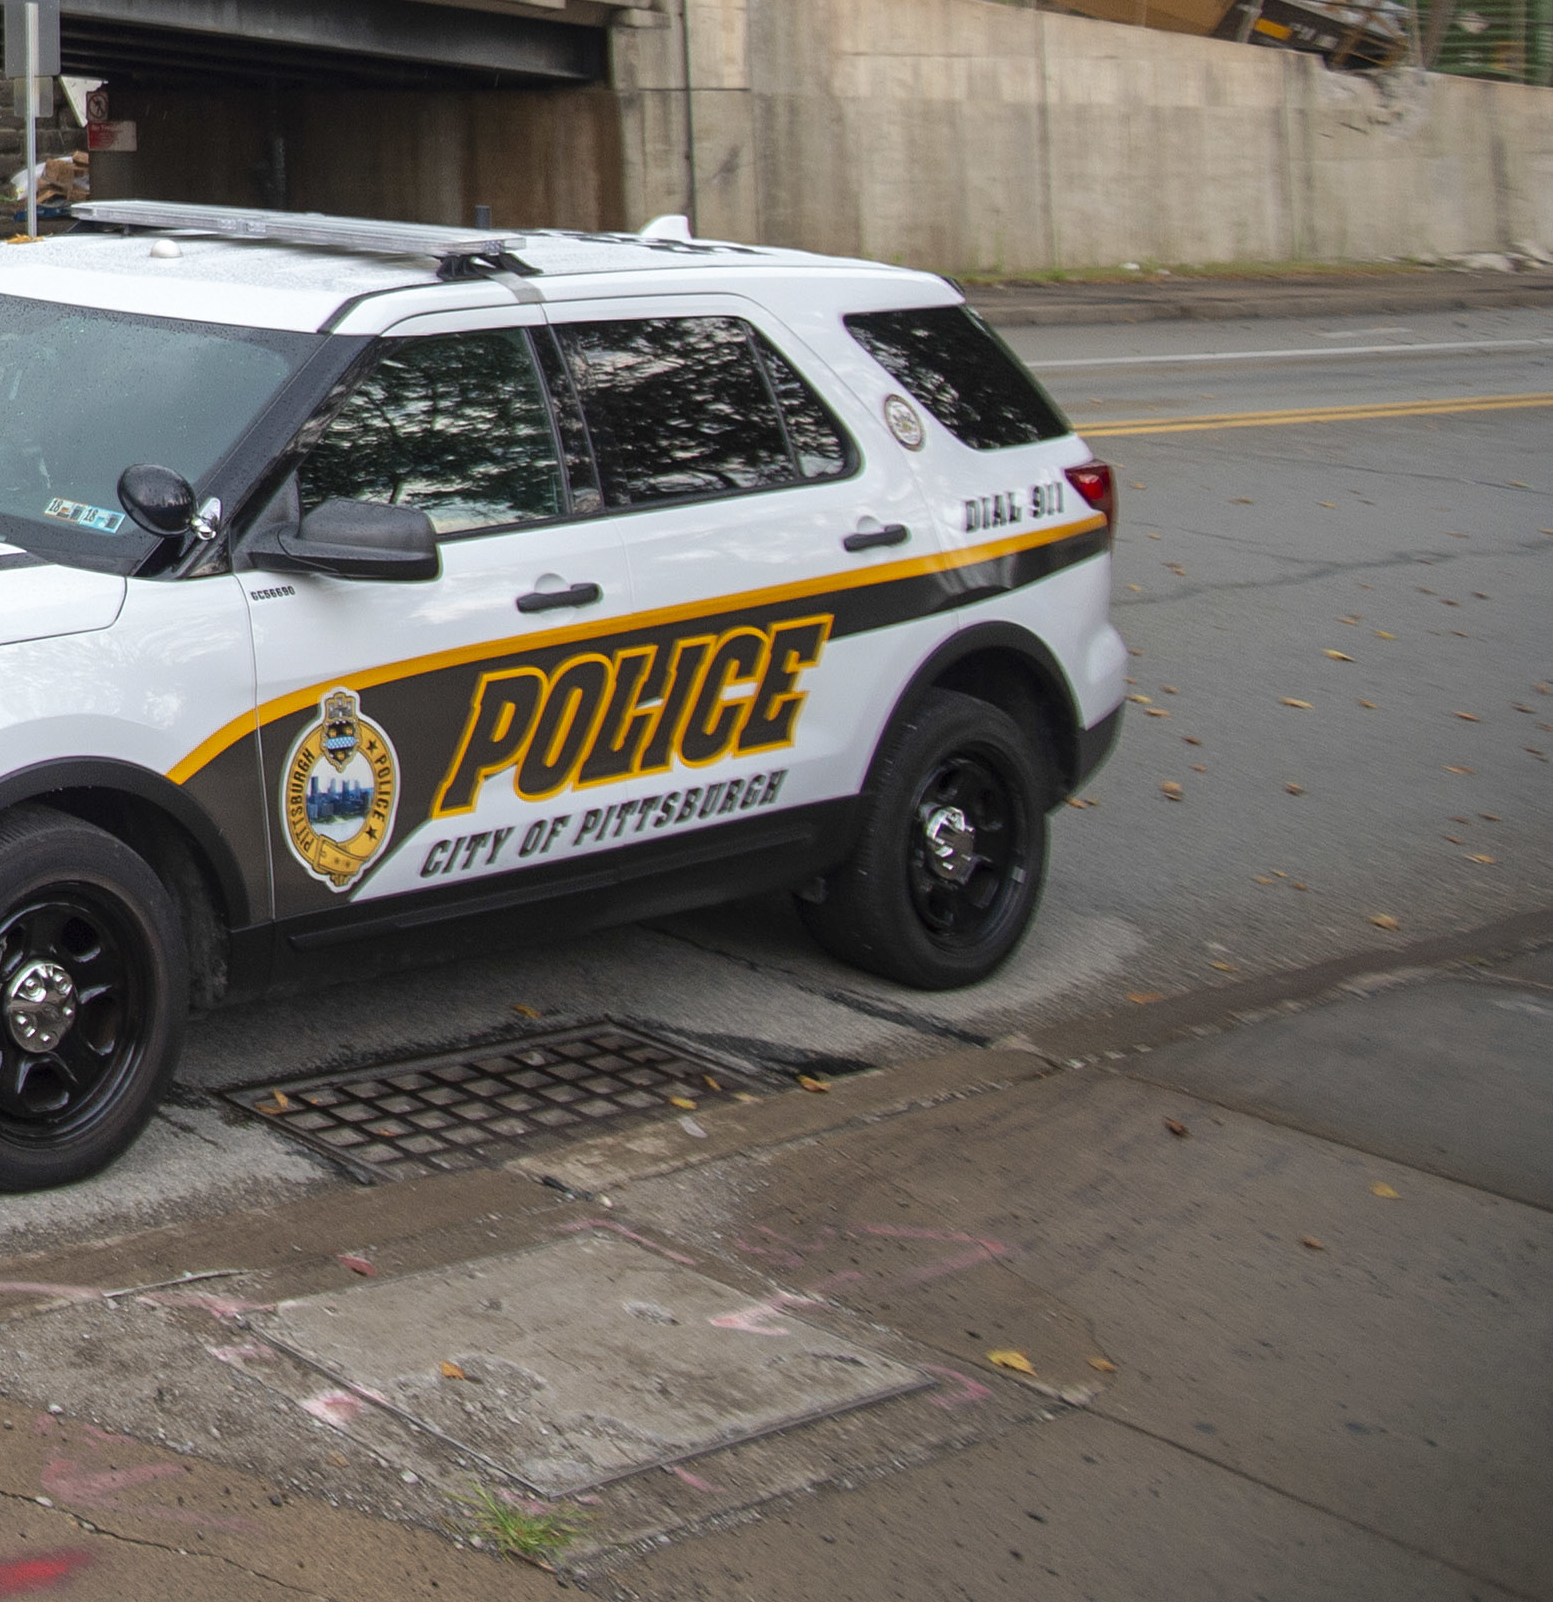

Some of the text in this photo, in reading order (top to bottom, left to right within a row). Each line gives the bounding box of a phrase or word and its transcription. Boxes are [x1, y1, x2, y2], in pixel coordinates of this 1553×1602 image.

[965, 481, 1065, 534] DIAL 911
[432, 612, 835, 821] POLICE
[290, 747, 316, 853] PITTSBURGH
[373, 754, 392, 823] POLICE
[420, 769, 790, 878] CITY OF PITTSBURGH
